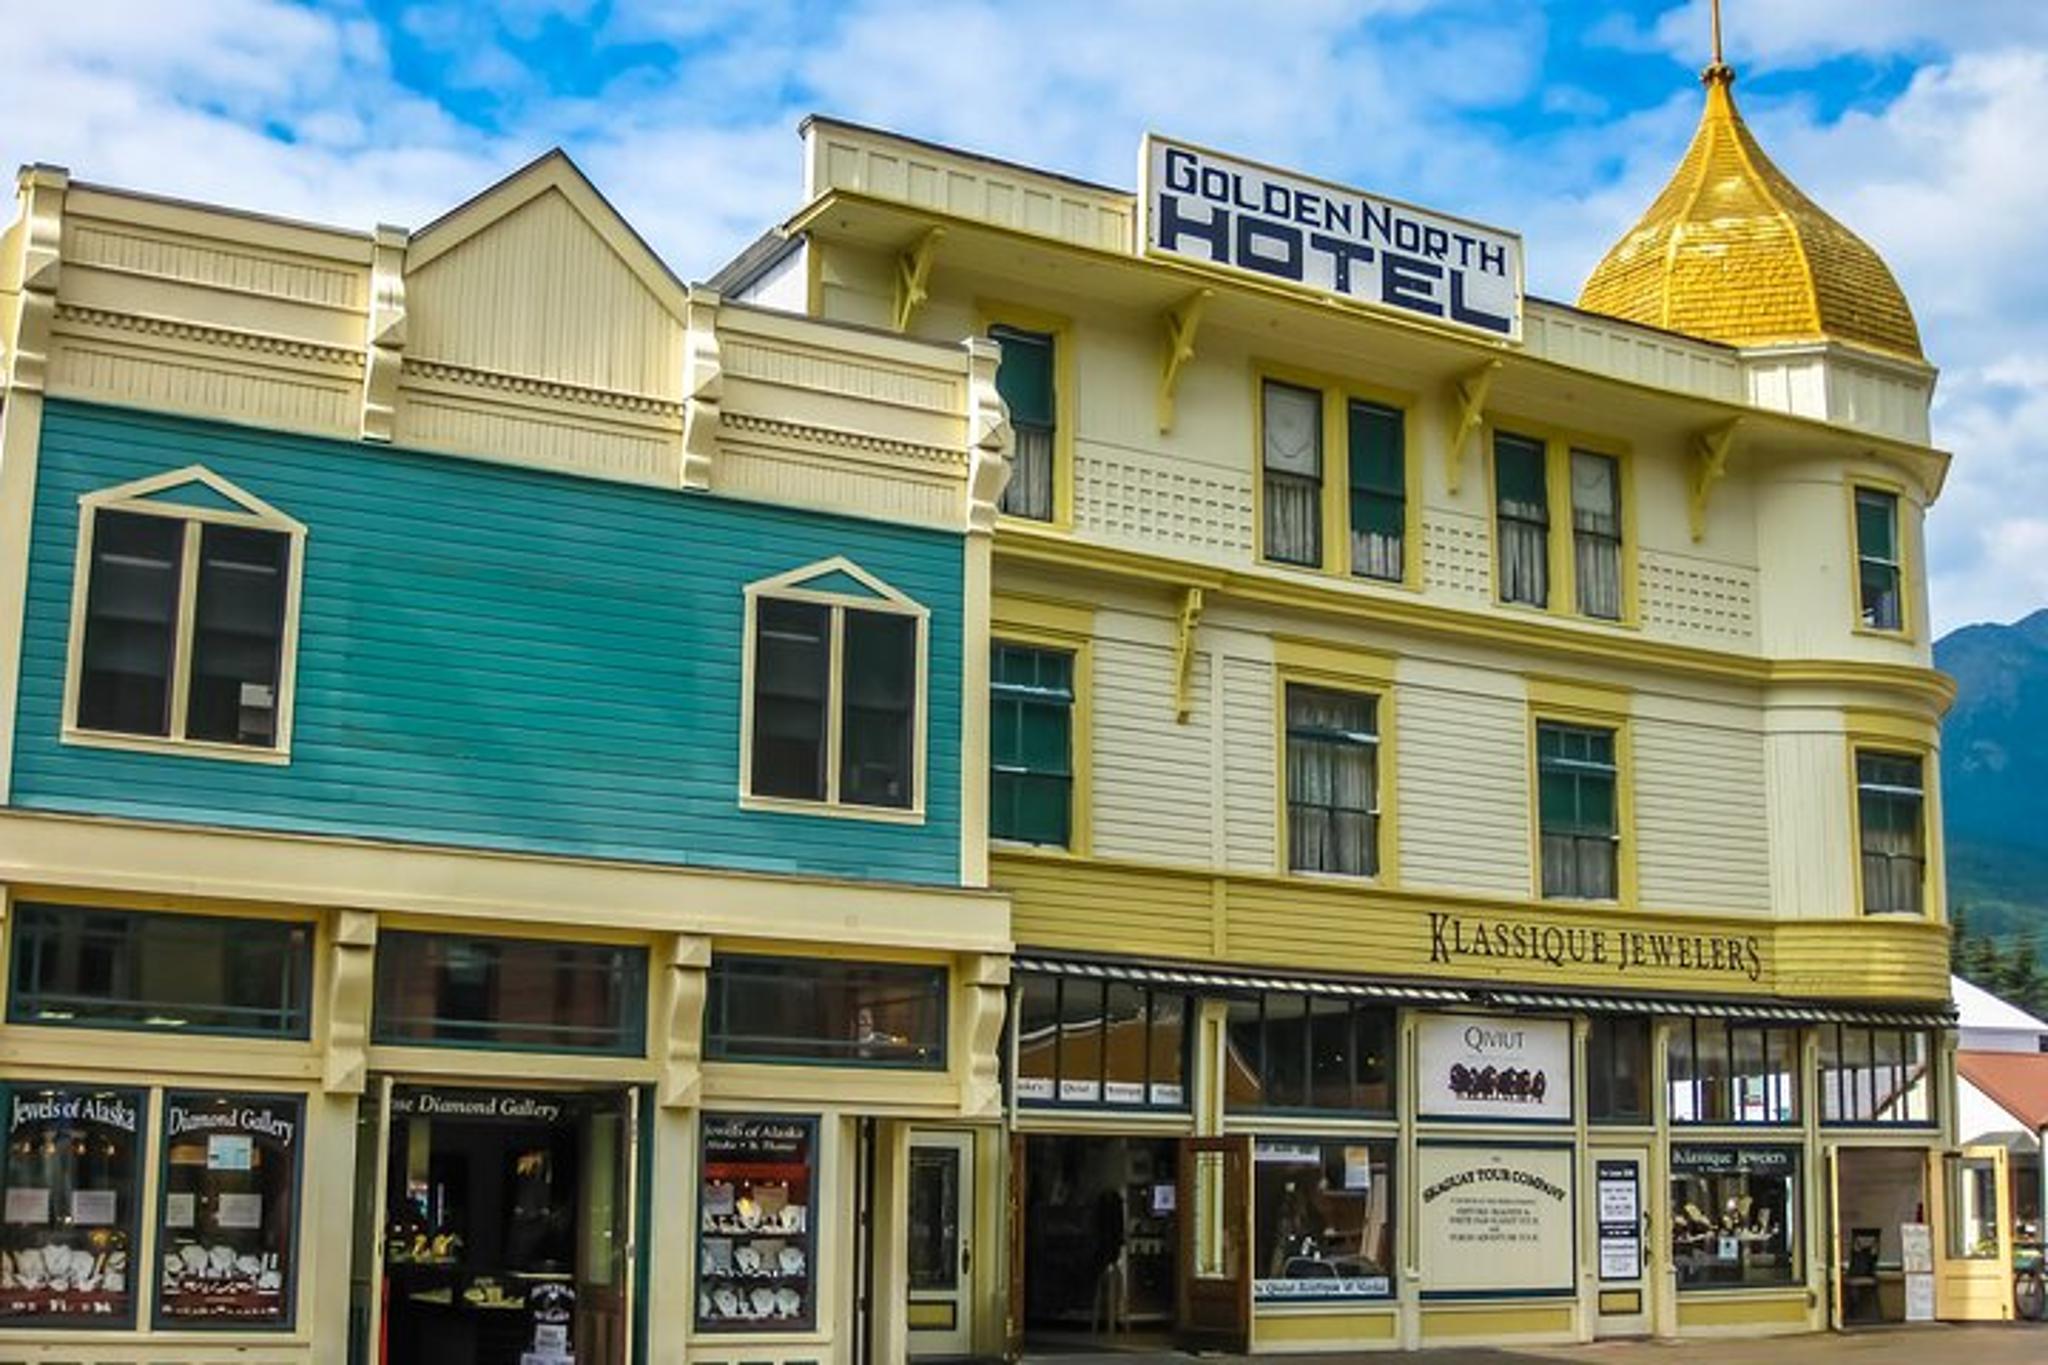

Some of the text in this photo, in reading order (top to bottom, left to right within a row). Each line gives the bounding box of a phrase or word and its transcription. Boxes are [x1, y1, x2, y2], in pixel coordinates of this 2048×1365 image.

[1159, 193, 1511, 334] HOTEL
[1428, 912, 1762, 982] KLASSIQUE JEWELERS
[11, 1096, 137, 1132] Jewels of Alaska
[169, 1106, 294, 1147] Diamond Gallery
[418, 1094, 496, 1116] Diamond
[500, 1097, 560, 1122] Gallery
